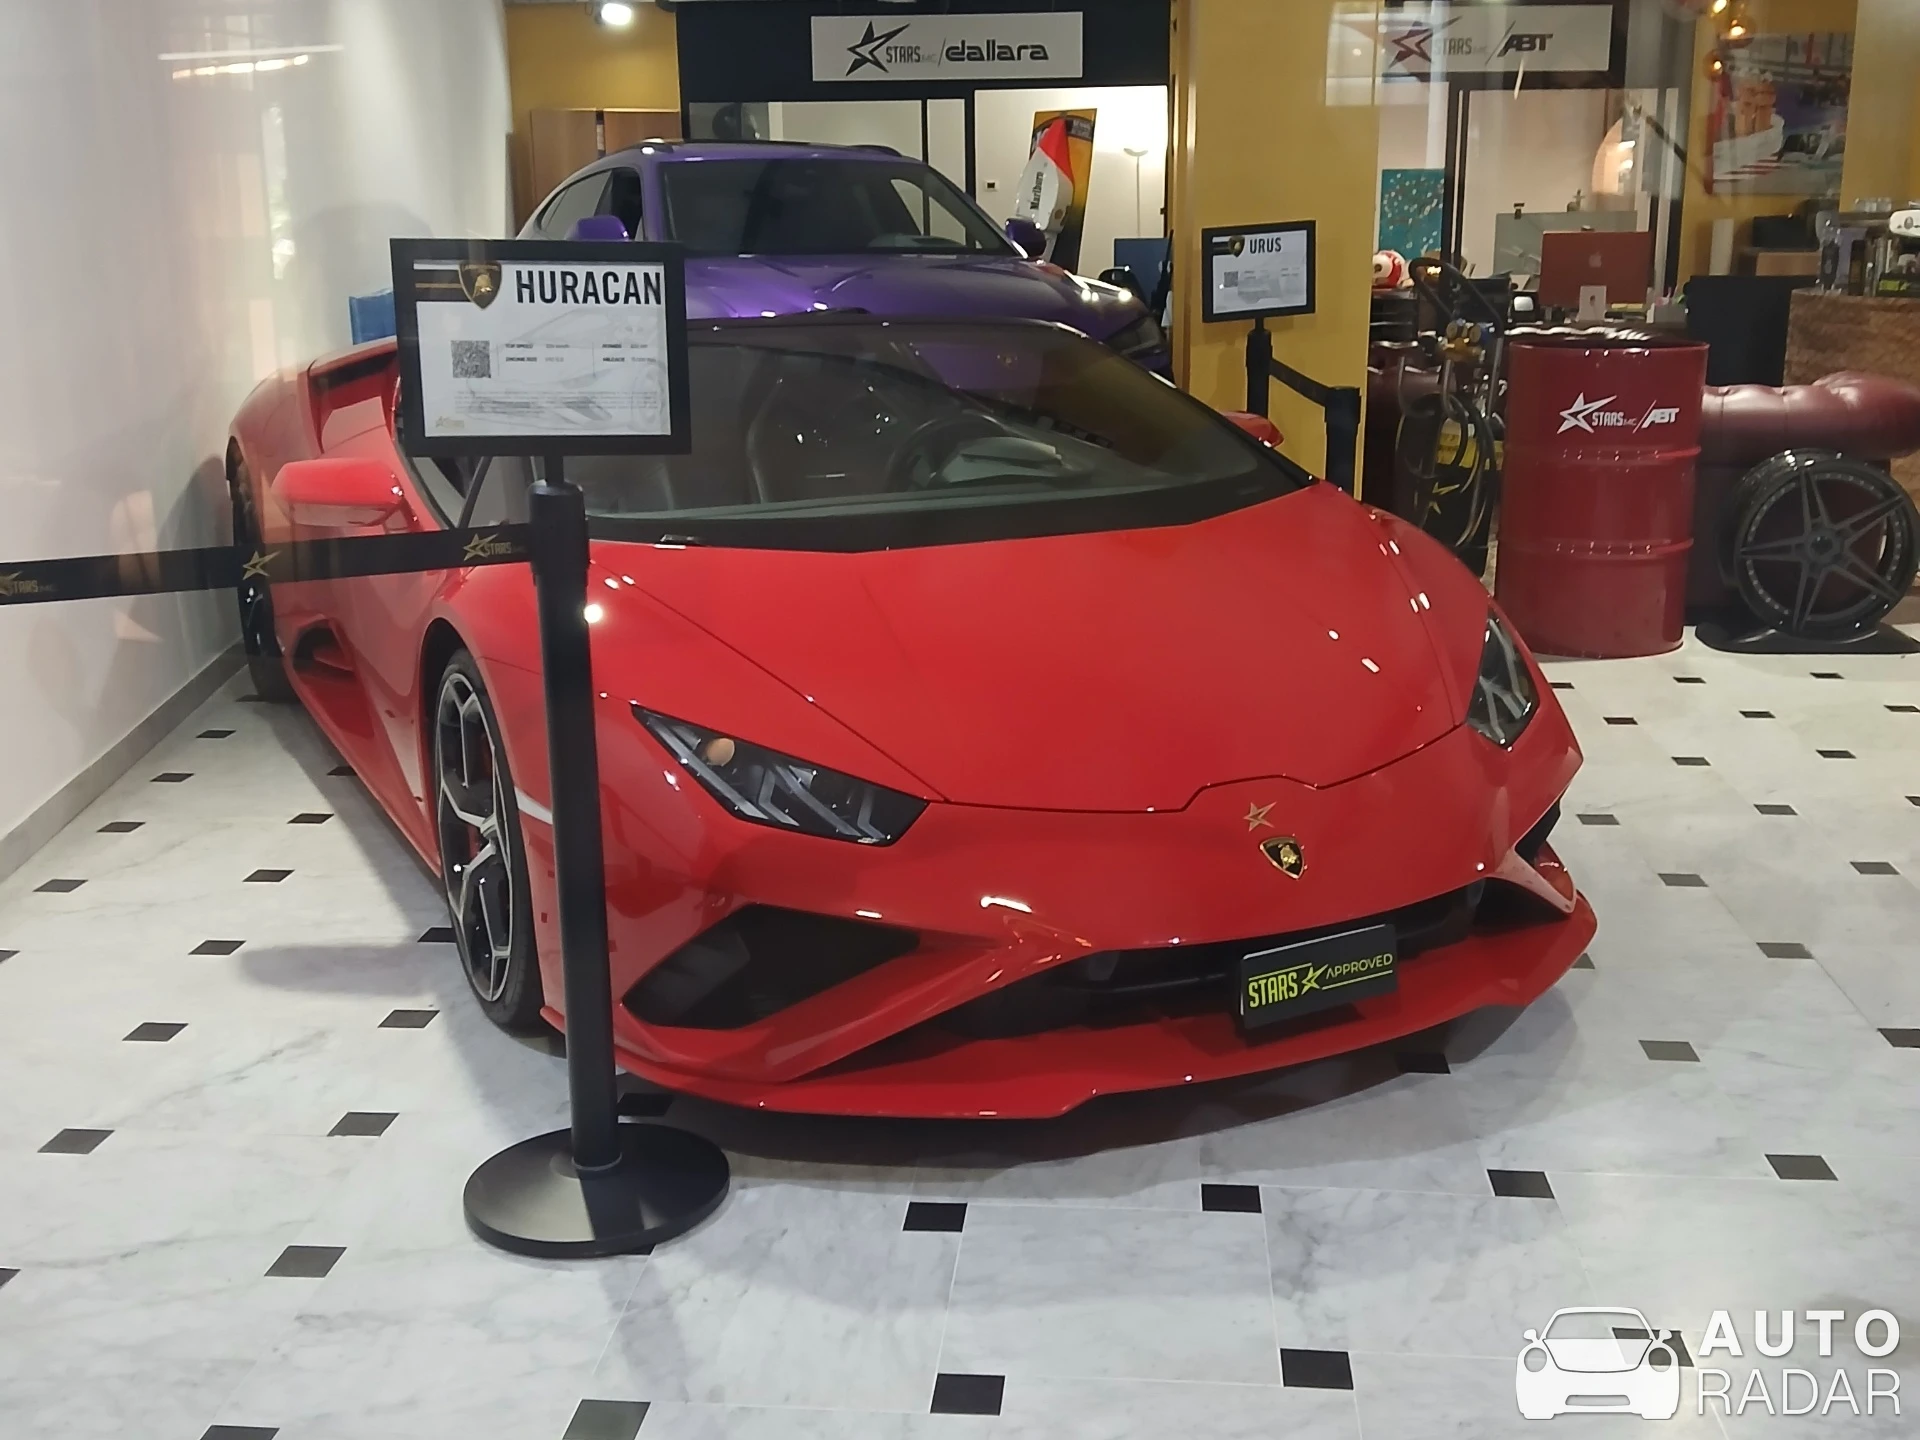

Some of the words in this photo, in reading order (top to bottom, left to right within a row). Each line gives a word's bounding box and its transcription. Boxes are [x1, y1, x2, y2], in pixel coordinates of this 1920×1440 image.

[885, 45, 922, 64] STARS
[945, 39, 1050, 62] dallara
[1434, 37, 1473, 55] STARS
[1496, 33, 1554, 57] ABT
[1030, 171, 1044, 210] Marlboro
[1249, 237, 1282, 254] URUS
[515, 269, 662, 305] HURACAN
[1591, 411, 1624, 427] STARS
[1641, 407, 1680, 428] ABT
[484, 542, 512, 556] STARS
[1248, 971, 1299, 1008] STARS
[1326, 953, 1394, 980] APPROVED
